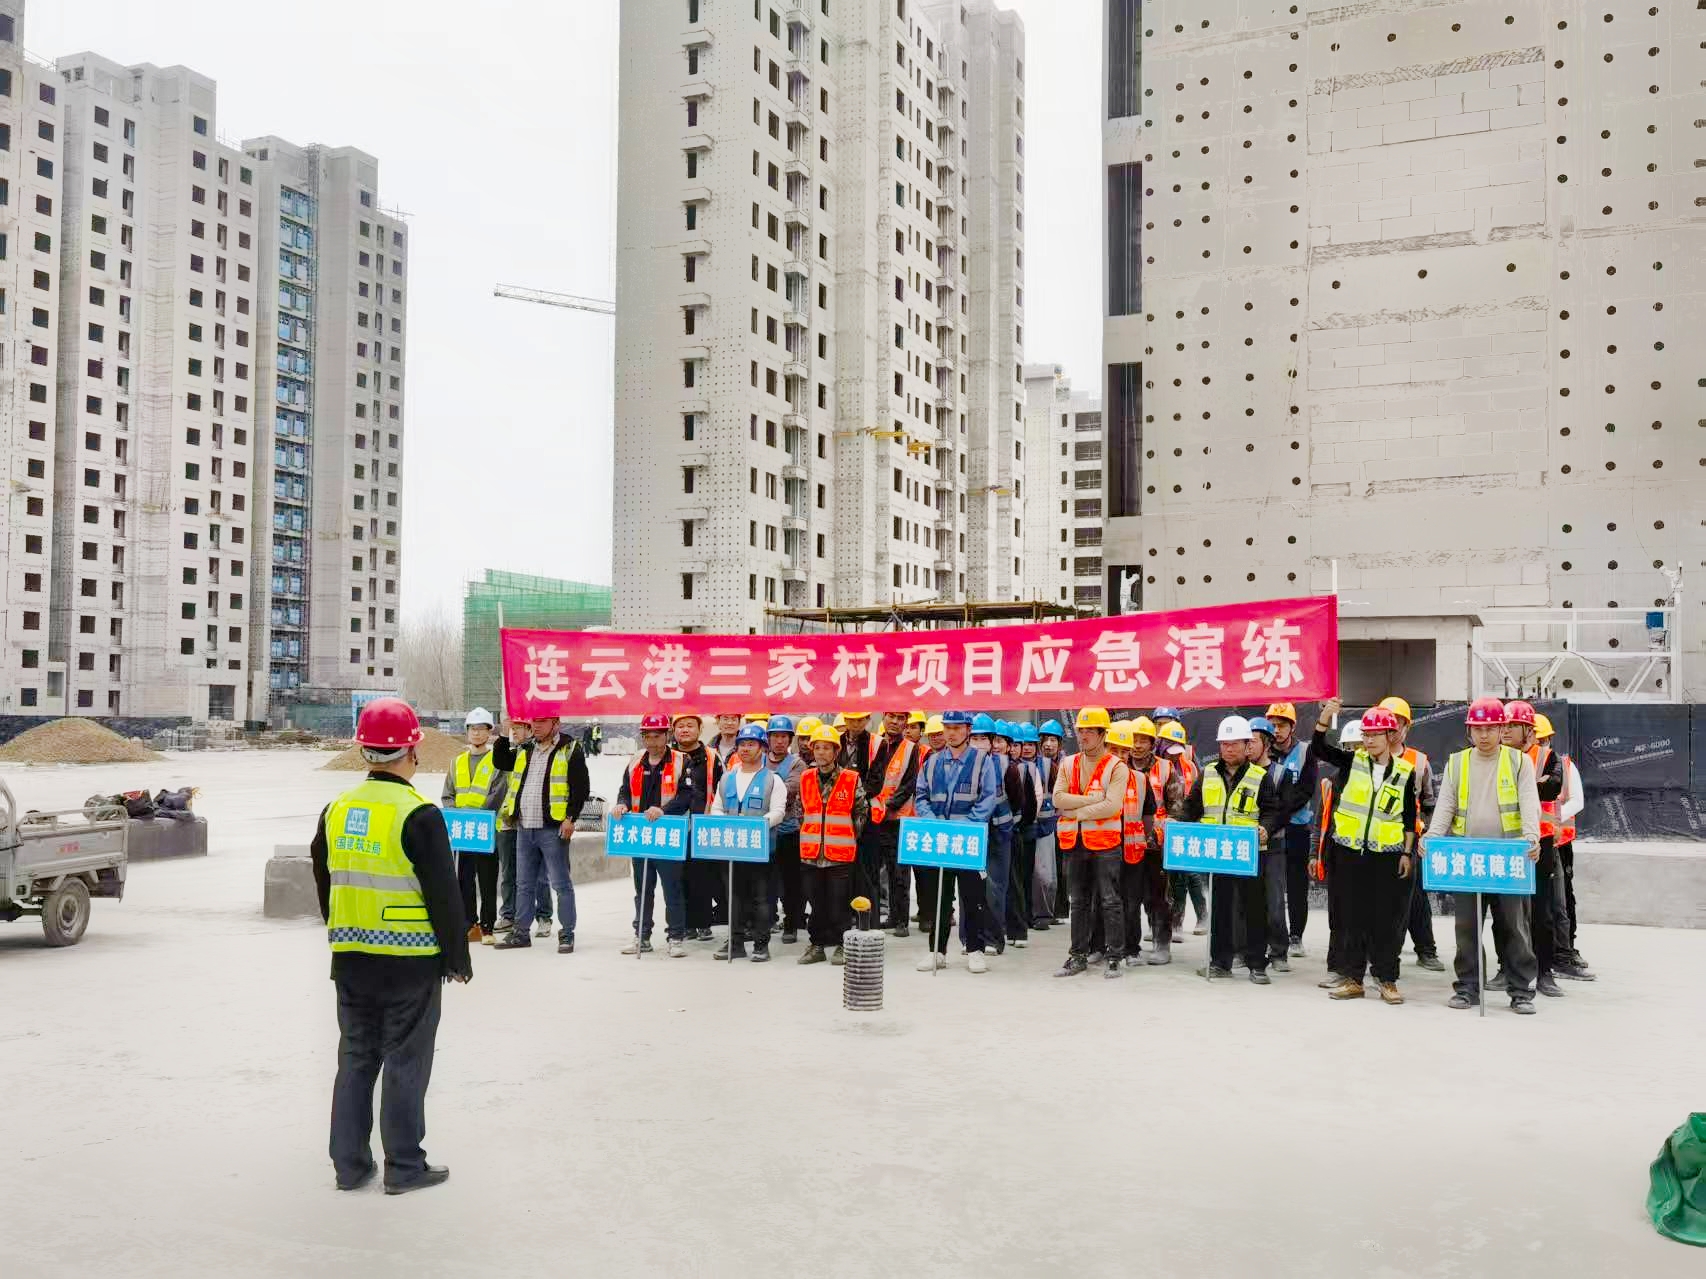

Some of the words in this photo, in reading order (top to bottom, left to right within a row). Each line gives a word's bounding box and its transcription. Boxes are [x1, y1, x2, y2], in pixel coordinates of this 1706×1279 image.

[524, 619, 1304, 701] 连云港三家村项目应急演练
[612, 823, 681, 848] 技术保障组
[697, 826, 762, 849] 抢险救援组
[905, 830, 980, 857] 安全警戒组
[1171, 834, 1251, 862] 事故调查组
[1431, 850, 1527, 879] 物资保障组
